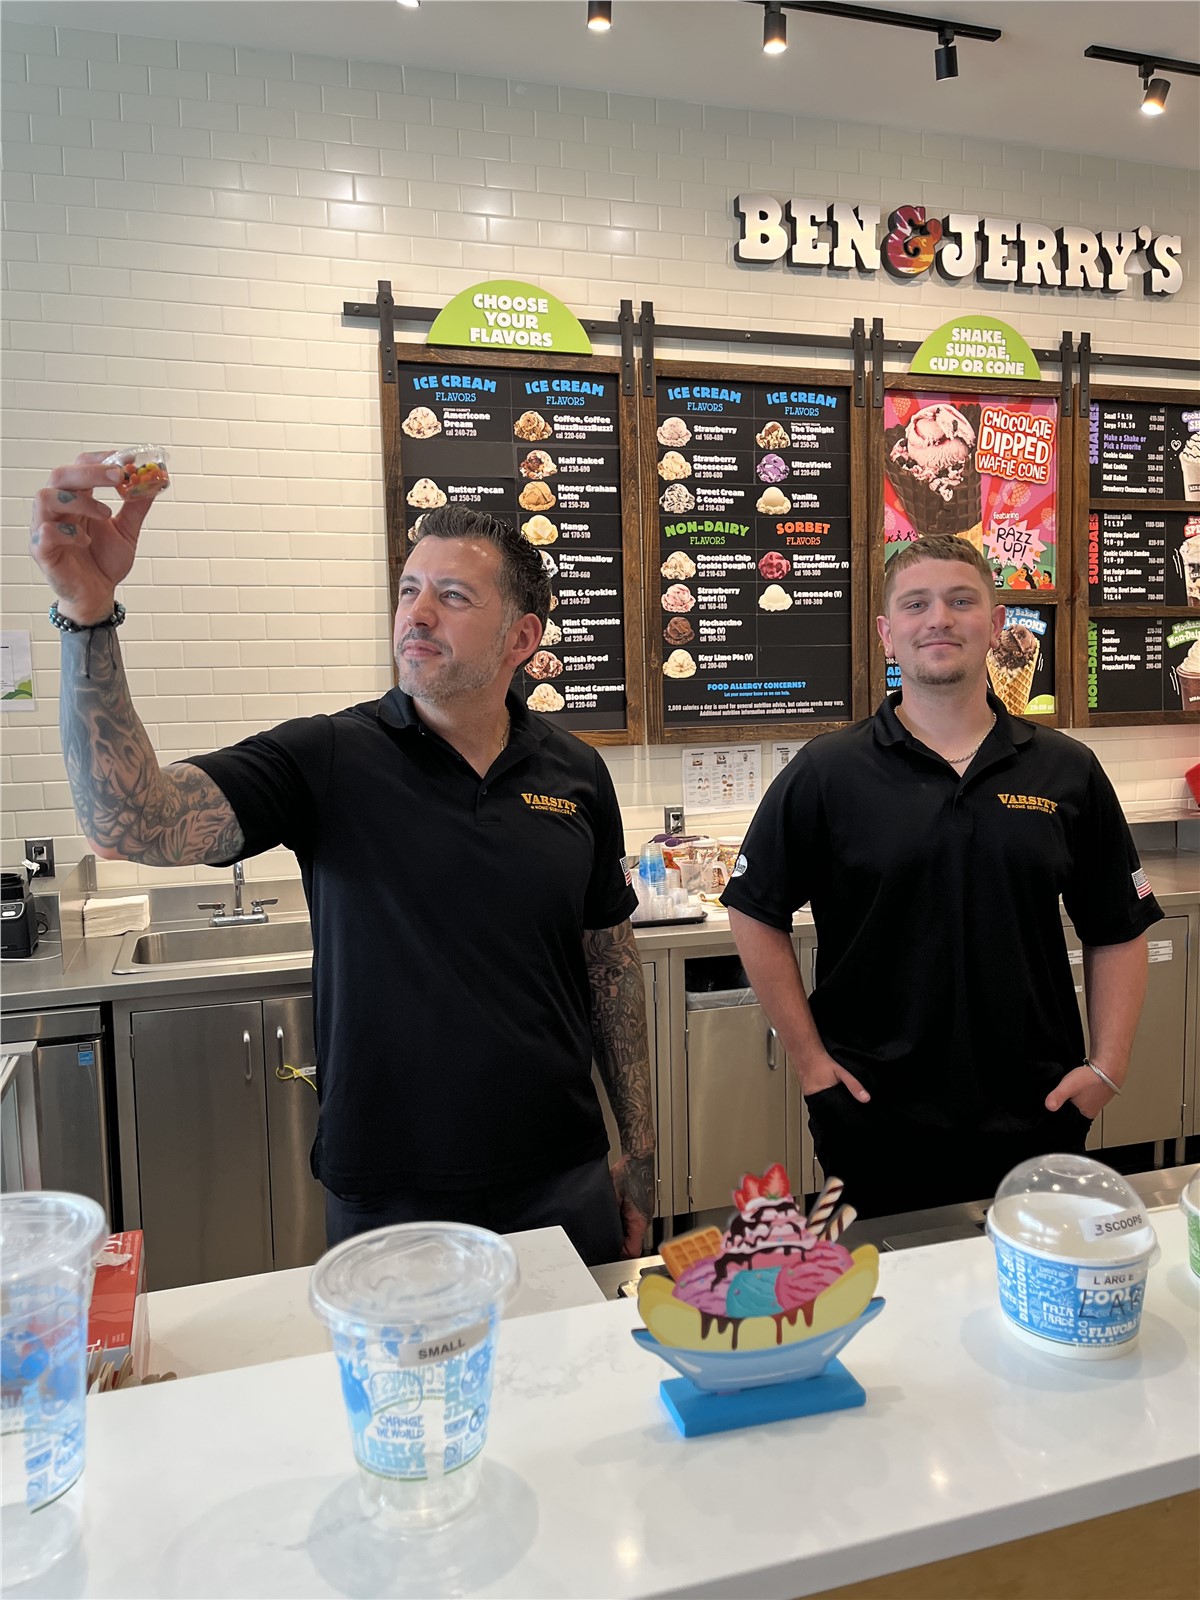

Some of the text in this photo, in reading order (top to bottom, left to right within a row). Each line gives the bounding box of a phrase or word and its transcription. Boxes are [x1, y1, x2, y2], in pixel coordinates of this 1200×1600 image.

[738, 195, 881, 269] BEN
[473, 294, 548, 313] CHOOSE
[485, 312, 538, 329] YOUR
[470, 328, 552, 346] FLAVORS
[952, 328, 1006, 345] SHAKE,
[946, 343, 1010, 360] SUNDAE,
[930, 358, 1024, 375] CUP OR CONE
[413, 375, 496, 392] ICE CREAM
[525, 380, 604, 396] ICE CREAM
[436, 392, 476, 402] FLAVORS
[546, 396, 585, 405] FLAVORS
[668, 387, 741, 403] ICE CREAM
[767, 392, 837, 408] ICE CREAM
[687, 402, 723, 411] FLAVORS
[785, 407, 819, 416] FLAVORS
[443, 412, 490, 420] Americone
[444, 420, 473, 428] Dream
[553, 415, 583, 423] Coffee,
[694, 425, 737, 434] Strawberry
[984, 410, 1051, 439] CHOCOLATE
[1089, 403, 1099, 464] SHAKES
[981, 426, 1048, 464] DIPPED
[693, 455, 736, 463] Strawberry
[693, 463, 738, 471] Cheesecake
[978, 453, 1046, 479] WAFFLE CONE
[558, 484, 584, 492] Honey
[704, 496, 734, 504] Cookies
[993, 512, 1019, 520] featuring
[665, 521, 749, 537] NON-DAIRY
[776, 522, 830, 534] SORBET
[997, 527, 1032, 545] RAZZ
[690, 537, 725, 545] FLAVORS
[787, 537, 820, 545] FLAVORS
[1089, 513, 1098, 584] SUNDAES
[559, 554, 613, 562] Marshmallow
[1003, 541, 1027, 561] UP!
[559, 562, 575, 570] Sky
[581, 618, 620, 626] Chocolate
[1016, 609, 1038, 619] Baked
[1019, 619, 1044, 632] CONE
[1088, 620, 1097, 707] NON-DAIRY
[521, 793, 577, 812] VARSITY
[998, 794, 1058, 812] VARSITY
[1095, 1215, 1143, 1237] 3 SCOOPS
[1042, 1301, 1075, 1317] FAIR
[1043, 1312, 1075, 1327] TRADE
[1089, 1320, 1138, 1338] FLAVORS
[418, 1338, 466, 1360] SMALL
[379, 1415, 424, 1428] CHANGE
[376, 1425, 424, 1441] THE WORLD
